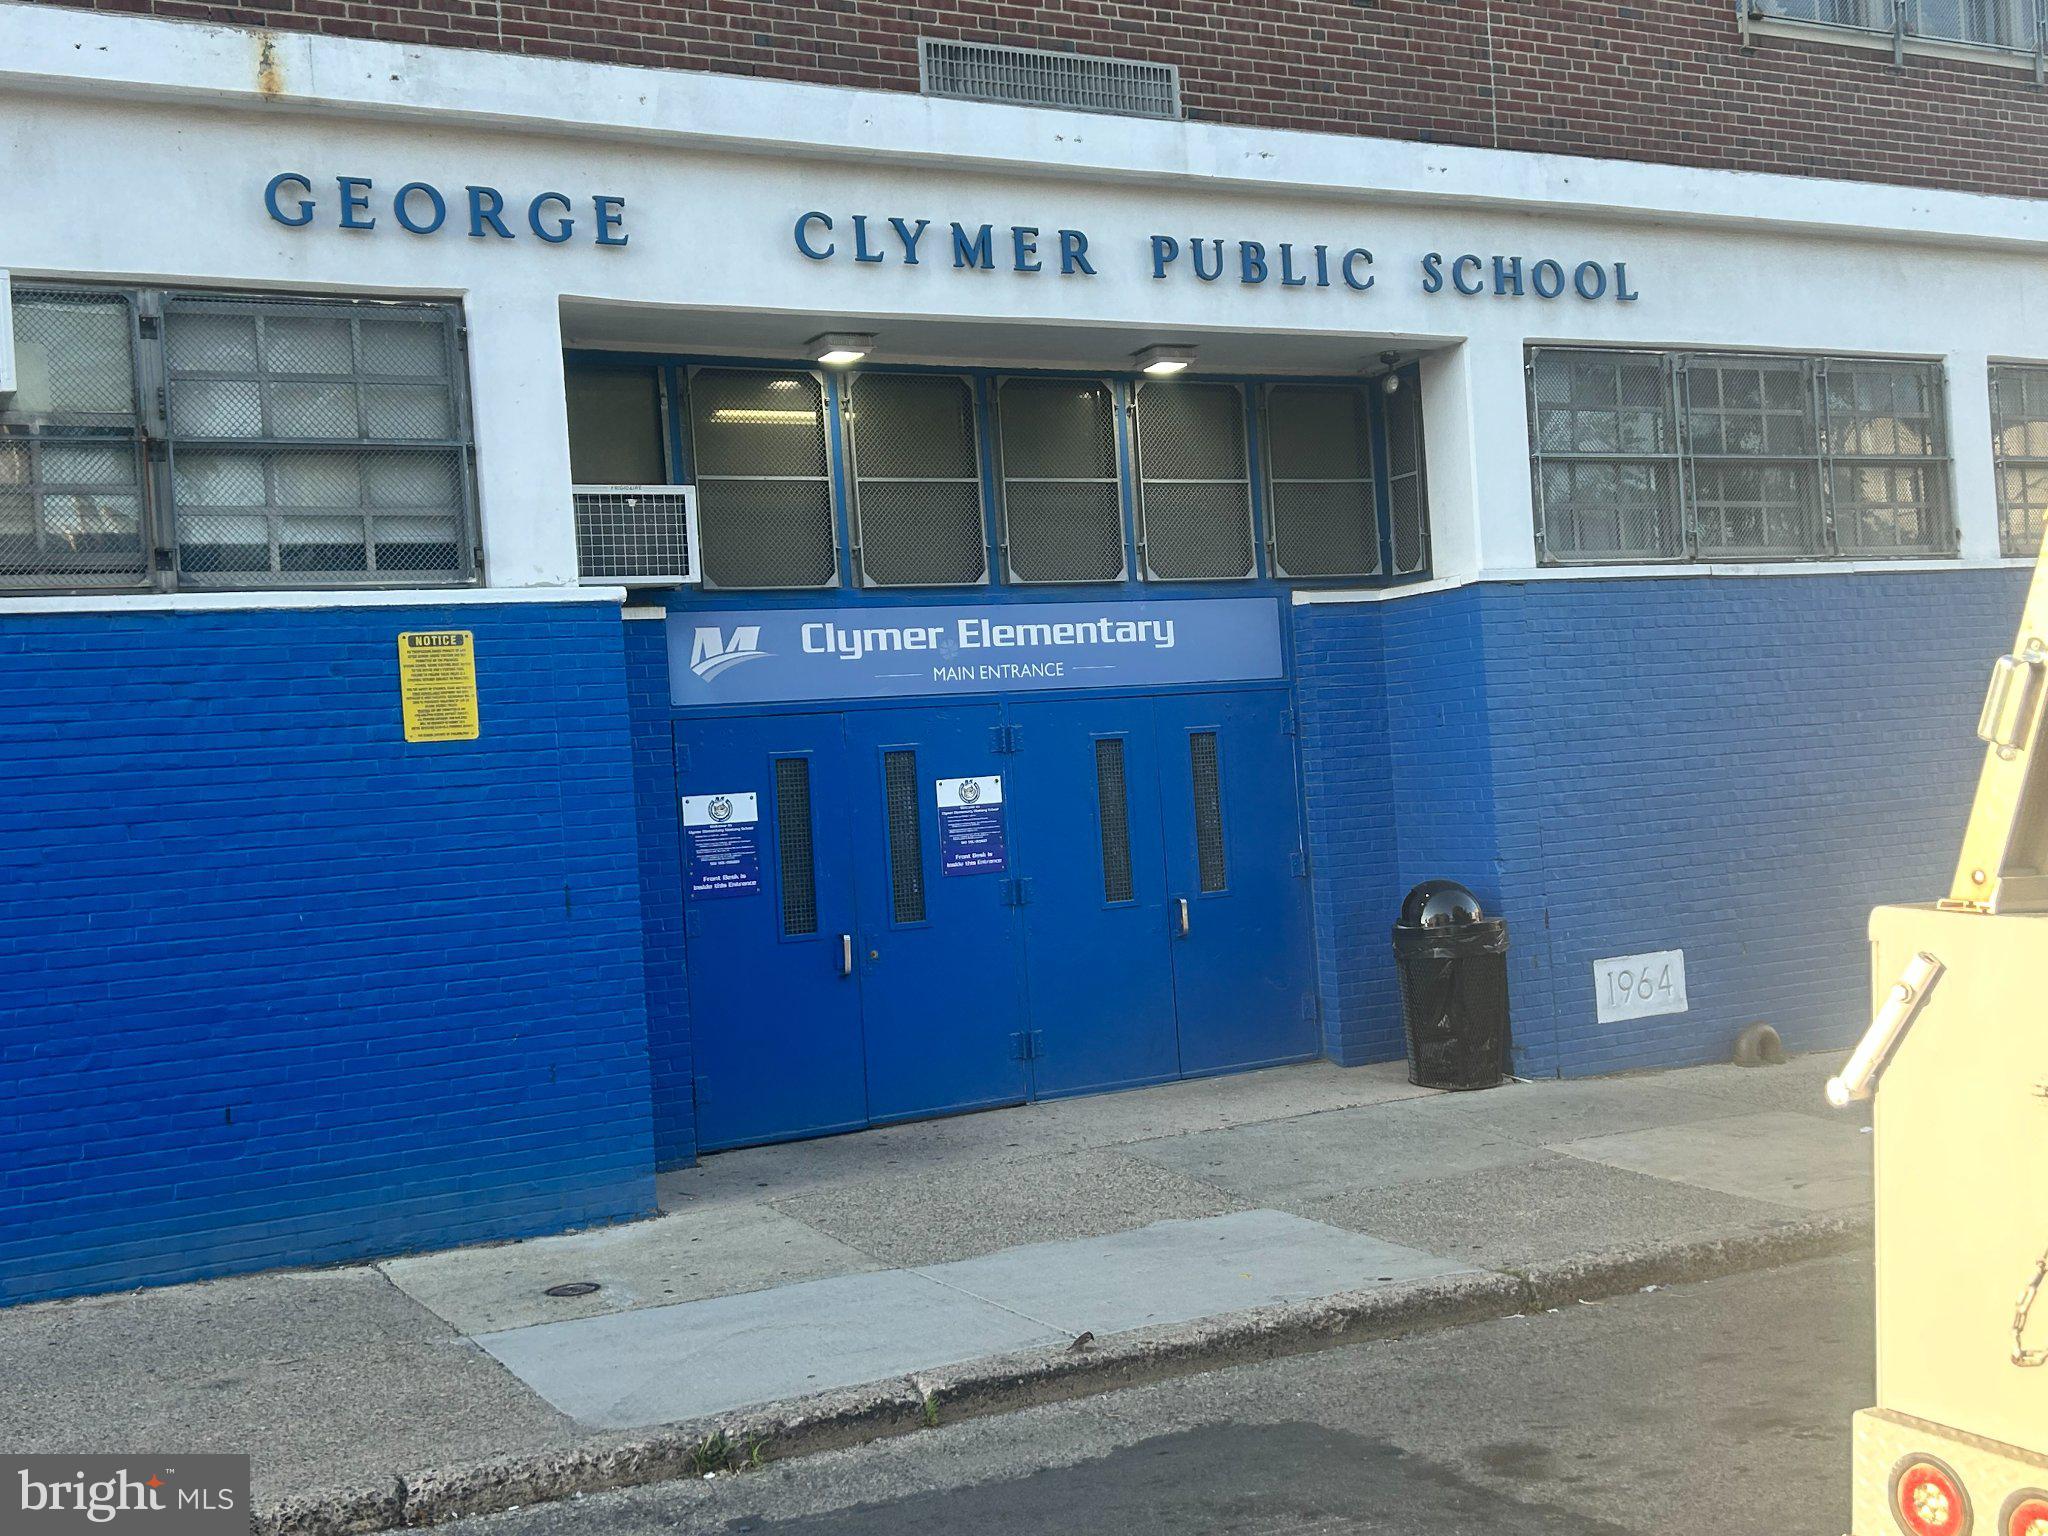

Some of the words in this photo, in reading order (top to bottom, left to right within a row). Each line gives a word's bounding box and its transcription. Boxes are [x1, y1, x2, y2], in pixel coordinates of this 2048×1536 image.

[264, 172, 629, 246] GEORGE
[794, 211, 1098, 276] CLYMER
[1150, 234, 1376, 291] PUBLIC
[1421, 251, 1639, 301] SCHOOL
[415, 635, 458, 646] NOTICE
[801, 622, 944, 660] Clymer
[957, 617, 1176, 649] Elementary
[933, 666, 975, 681] MAIN
[979, 662, 1065, 680] ENTRANCE
[728, 880, 757, 888] Entrance
[1607, 964, 1673, 1007] 1964
